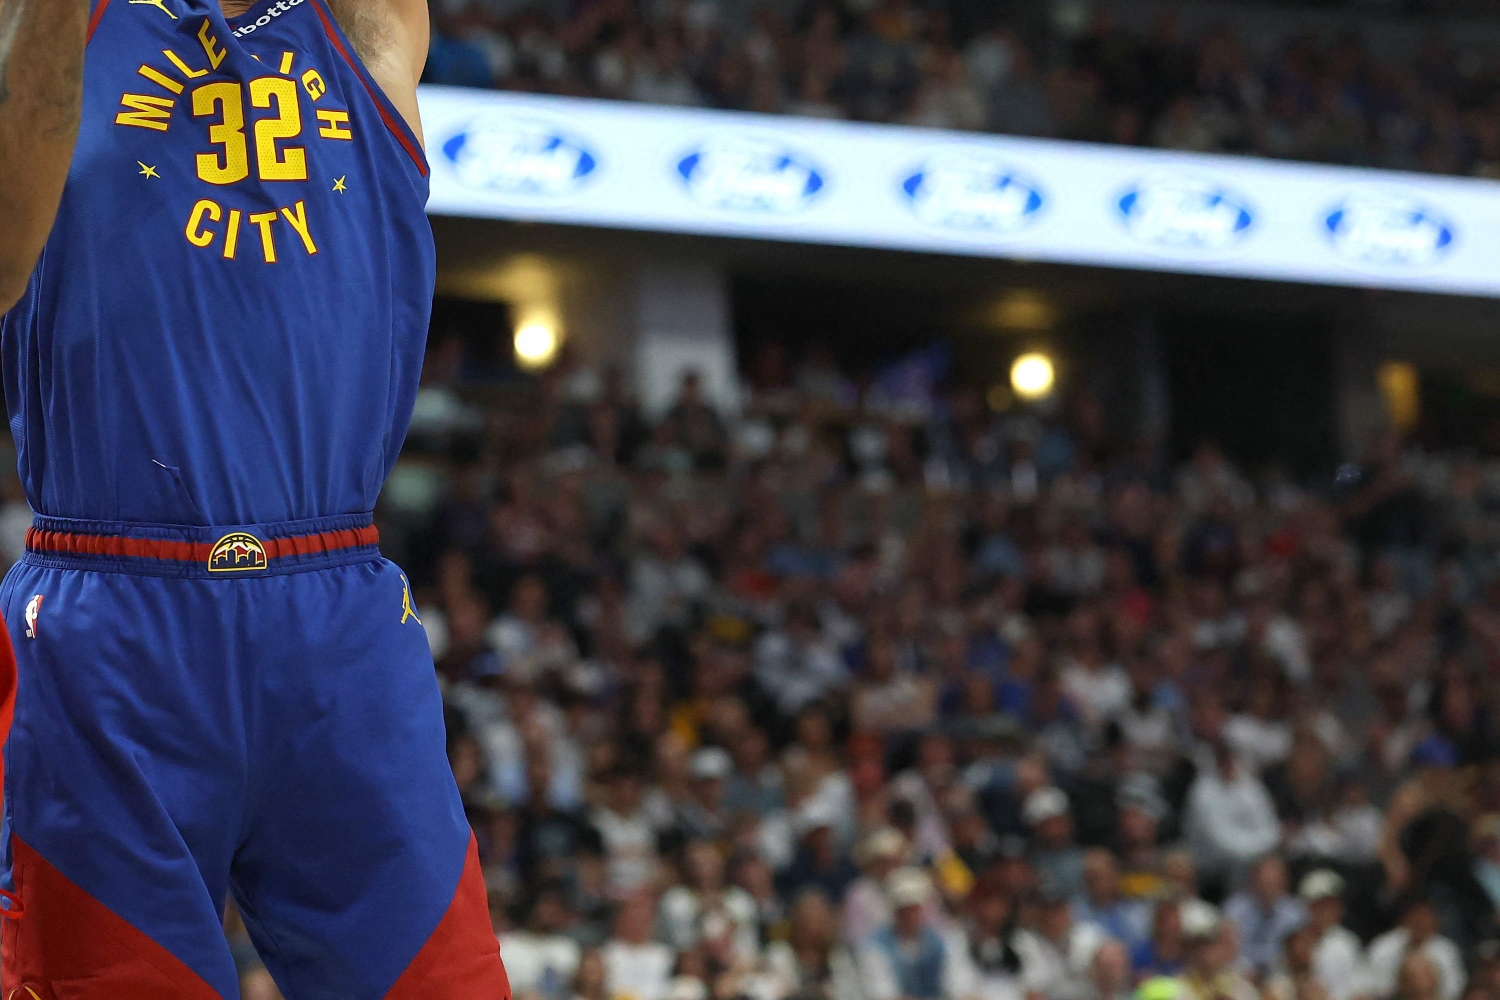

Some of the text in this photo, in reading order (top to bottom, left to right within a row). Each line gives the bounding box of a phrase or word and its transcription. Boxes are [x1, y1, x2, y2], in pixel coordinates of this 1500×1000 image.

[114, 18, 352, 140] MILE IGH
[191, 76, 308, 185] 32
[184, 199, 318, 263] CITY
